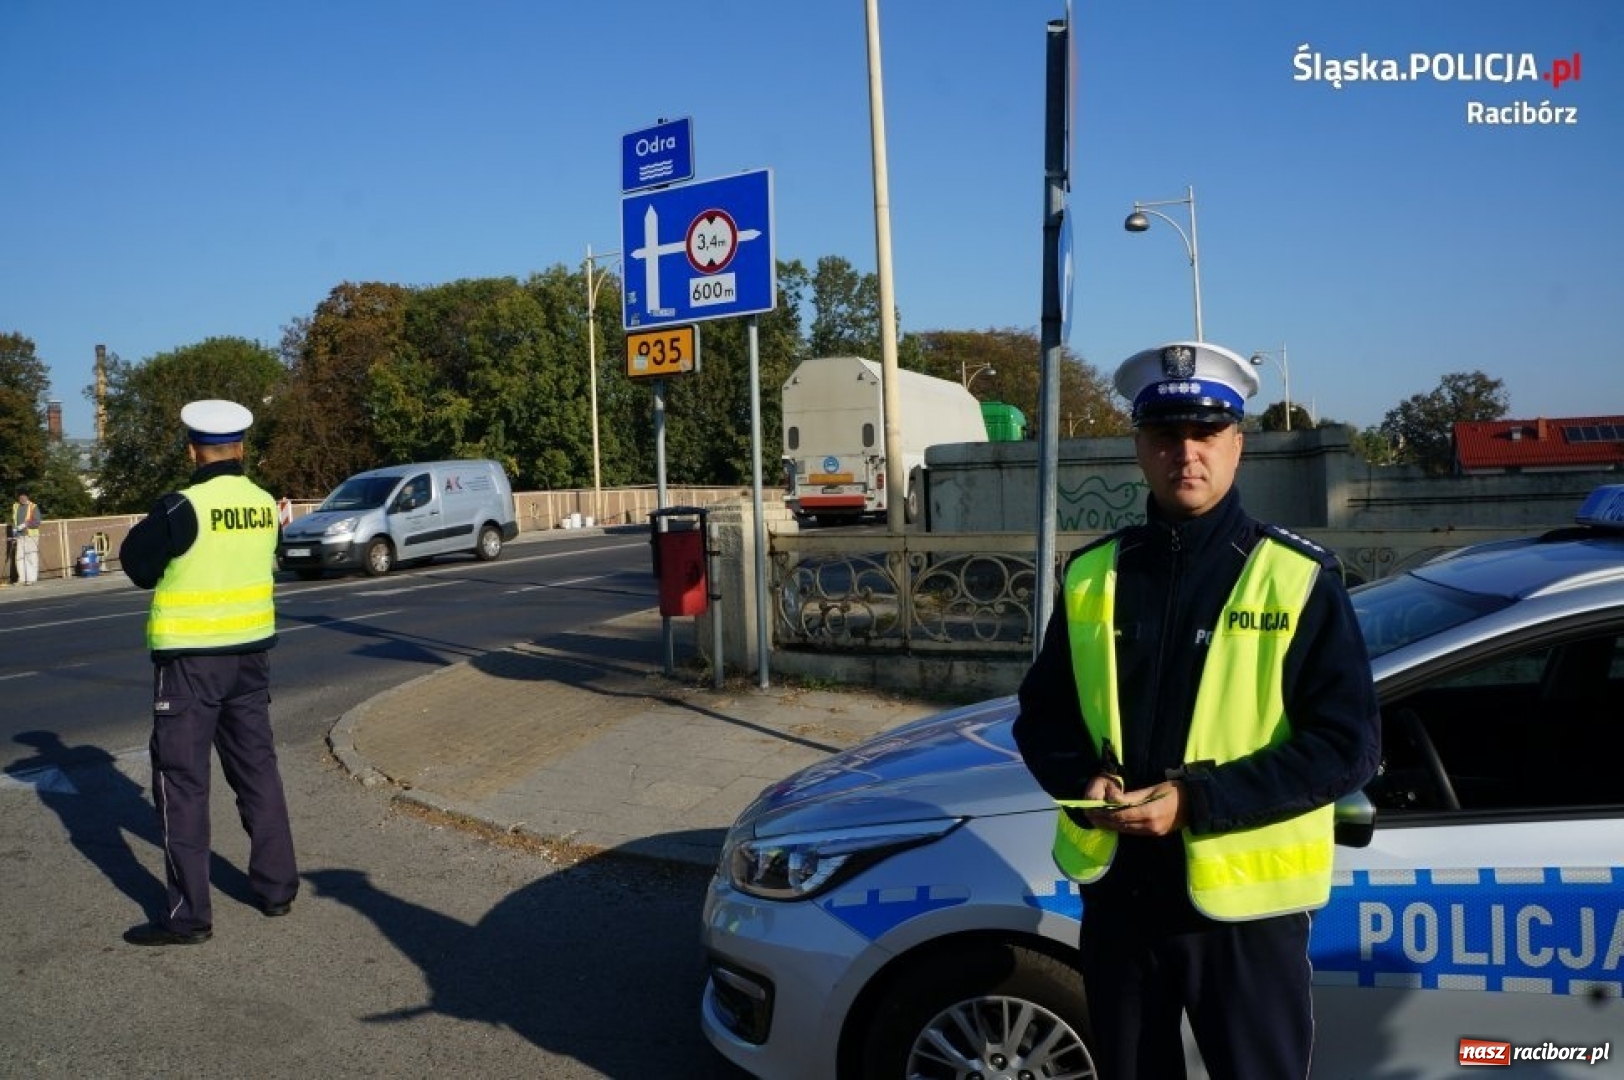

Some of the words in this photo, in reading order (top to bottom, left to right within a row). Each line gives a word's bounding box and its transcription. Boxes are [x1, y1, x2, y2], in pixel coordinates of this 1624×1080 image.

[636, 135, 676, 156] Odra
[638, 337, 682, 366] 935
[211, 507, 274, 531] POLICJA
[1228, 611, 1290, 631] POLICJA
